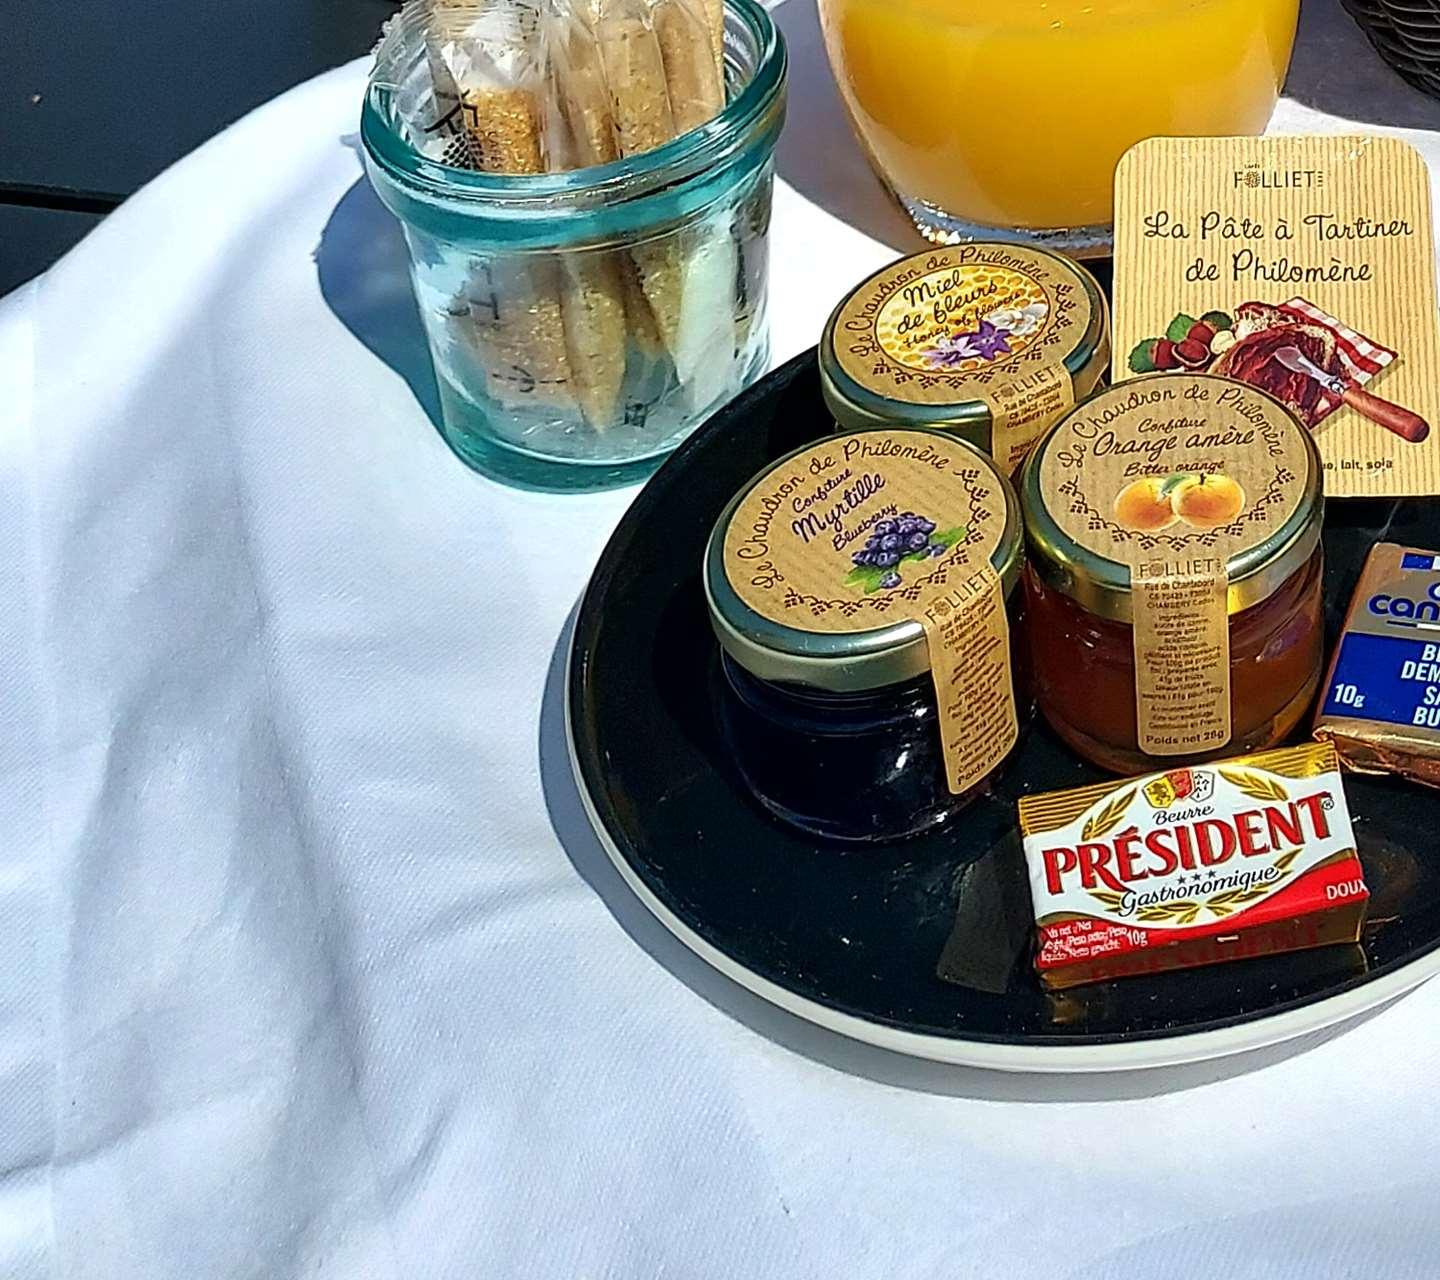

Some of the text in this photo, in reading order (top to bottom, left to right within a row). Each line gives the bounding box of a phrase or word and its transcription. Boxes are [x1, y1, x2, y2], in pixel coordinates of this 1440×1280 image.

[1144, 211, 1414, 240] La Pâte à Tartiner
[1185, 249, 1373, 282] de Philomène
[845, 268, 921, 332] Chaudron
[926, 256, 950, 270] de
[959, 246, 1049, 282] Philomène
[897, 280, 997, 335] de fleurs
[903, 269, 964, 307] Miel
[1072, 388, 1177, 437] Chaudron
[1183, 385, 1209, 401] de
[1215, 387, 1285, 459] Philomène
[1138, 417, 1207, 434] Confiture
[1093, 430, 1177, 463] Orange
[1175, 460, 1225, 476] orange
[737, 474, 806, 560] Chaudron
[809, 455, 836, 475] de
[843, 439, 950, 471] Philomène
[791, 473, 886, 544] Myrtille
[792, 467, 853, 514] Confiture
[831, 502, 898, 551] Blueberry
[1334, 682, 1366, 708] 10g
[1152, 804, 1216, 826] Beurre
[1042, 791, 1333, 896] PRÉSIDENT
[1117, 865, 1281, 918] Gastronomique
[1126, 929, 1148, 947] 10g
